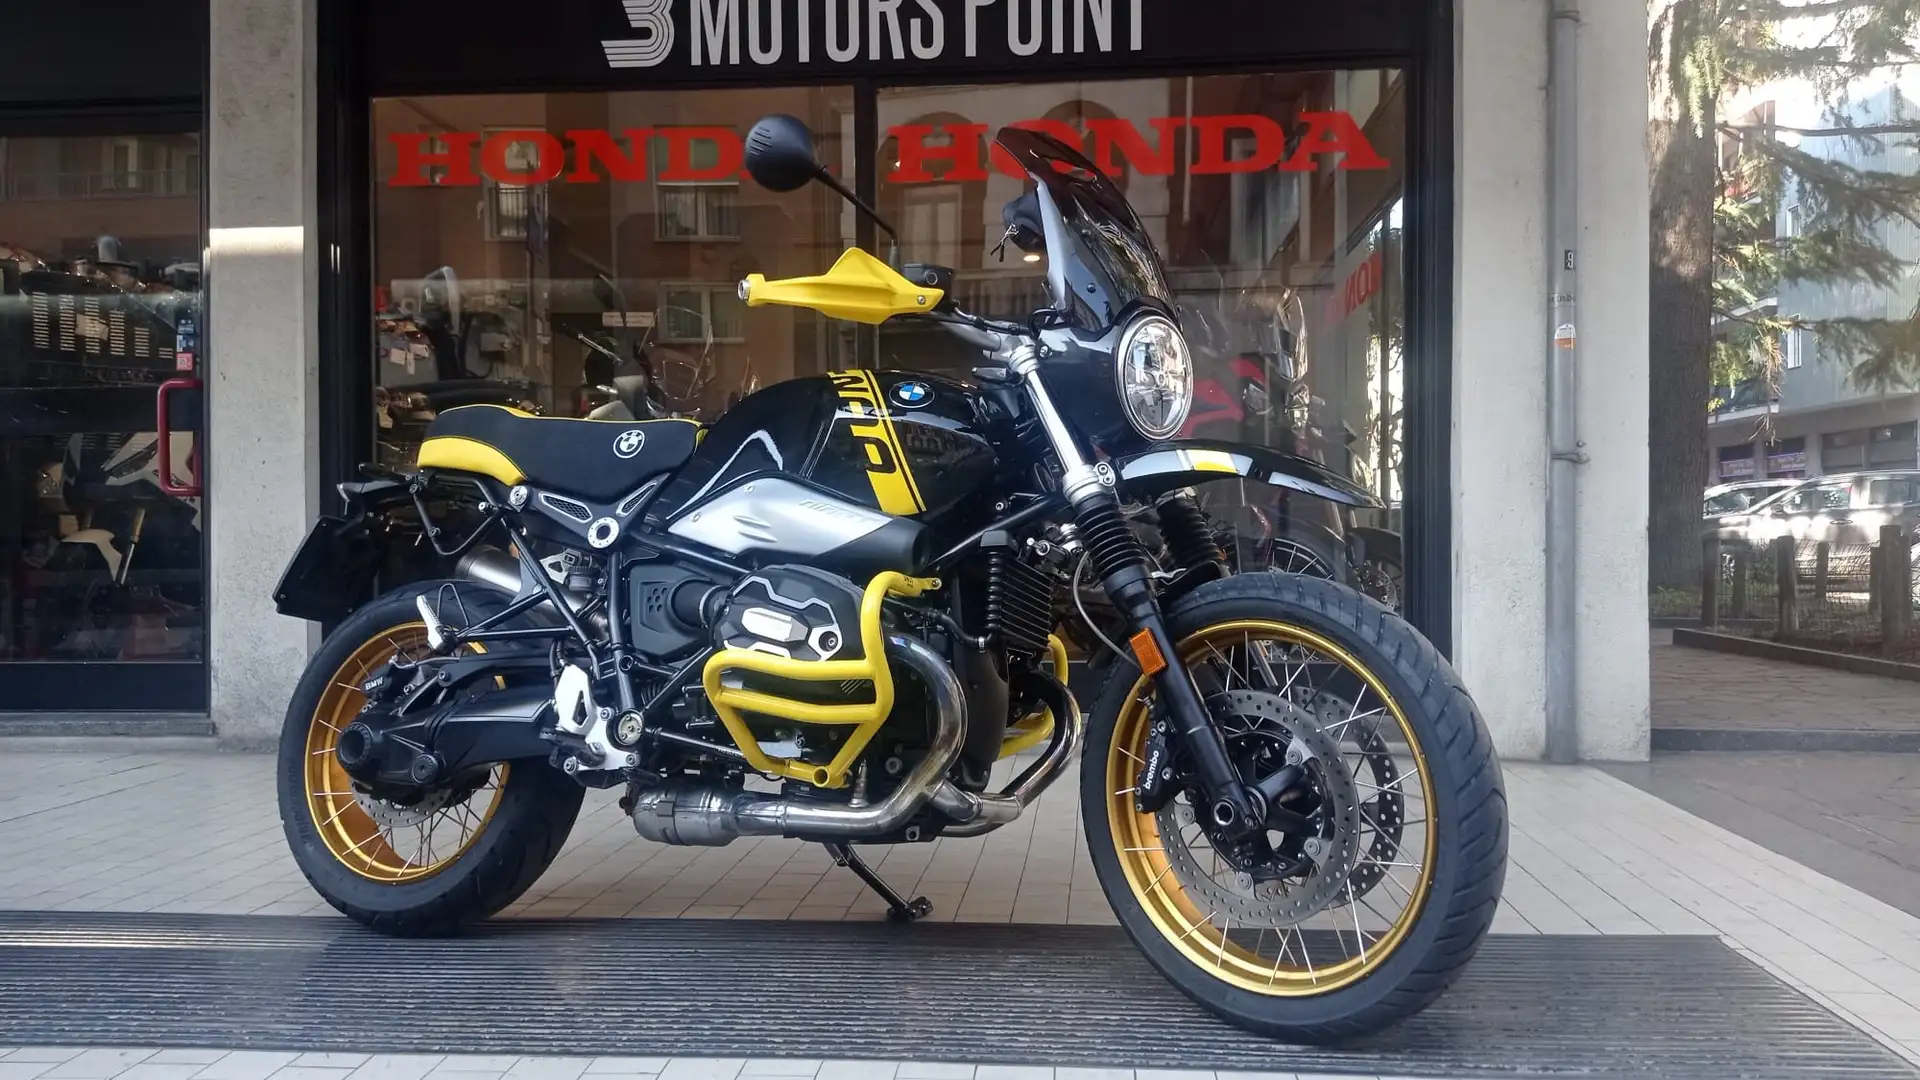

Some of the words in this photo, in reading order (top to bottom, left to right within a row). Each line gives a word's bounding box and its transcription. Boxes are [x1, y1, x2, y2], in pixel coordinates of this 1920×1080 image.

[387, 127, 754, 187] HOND
[365, 676, 383, 690] BMW
[1143, 750, 1159, 790] brembo
